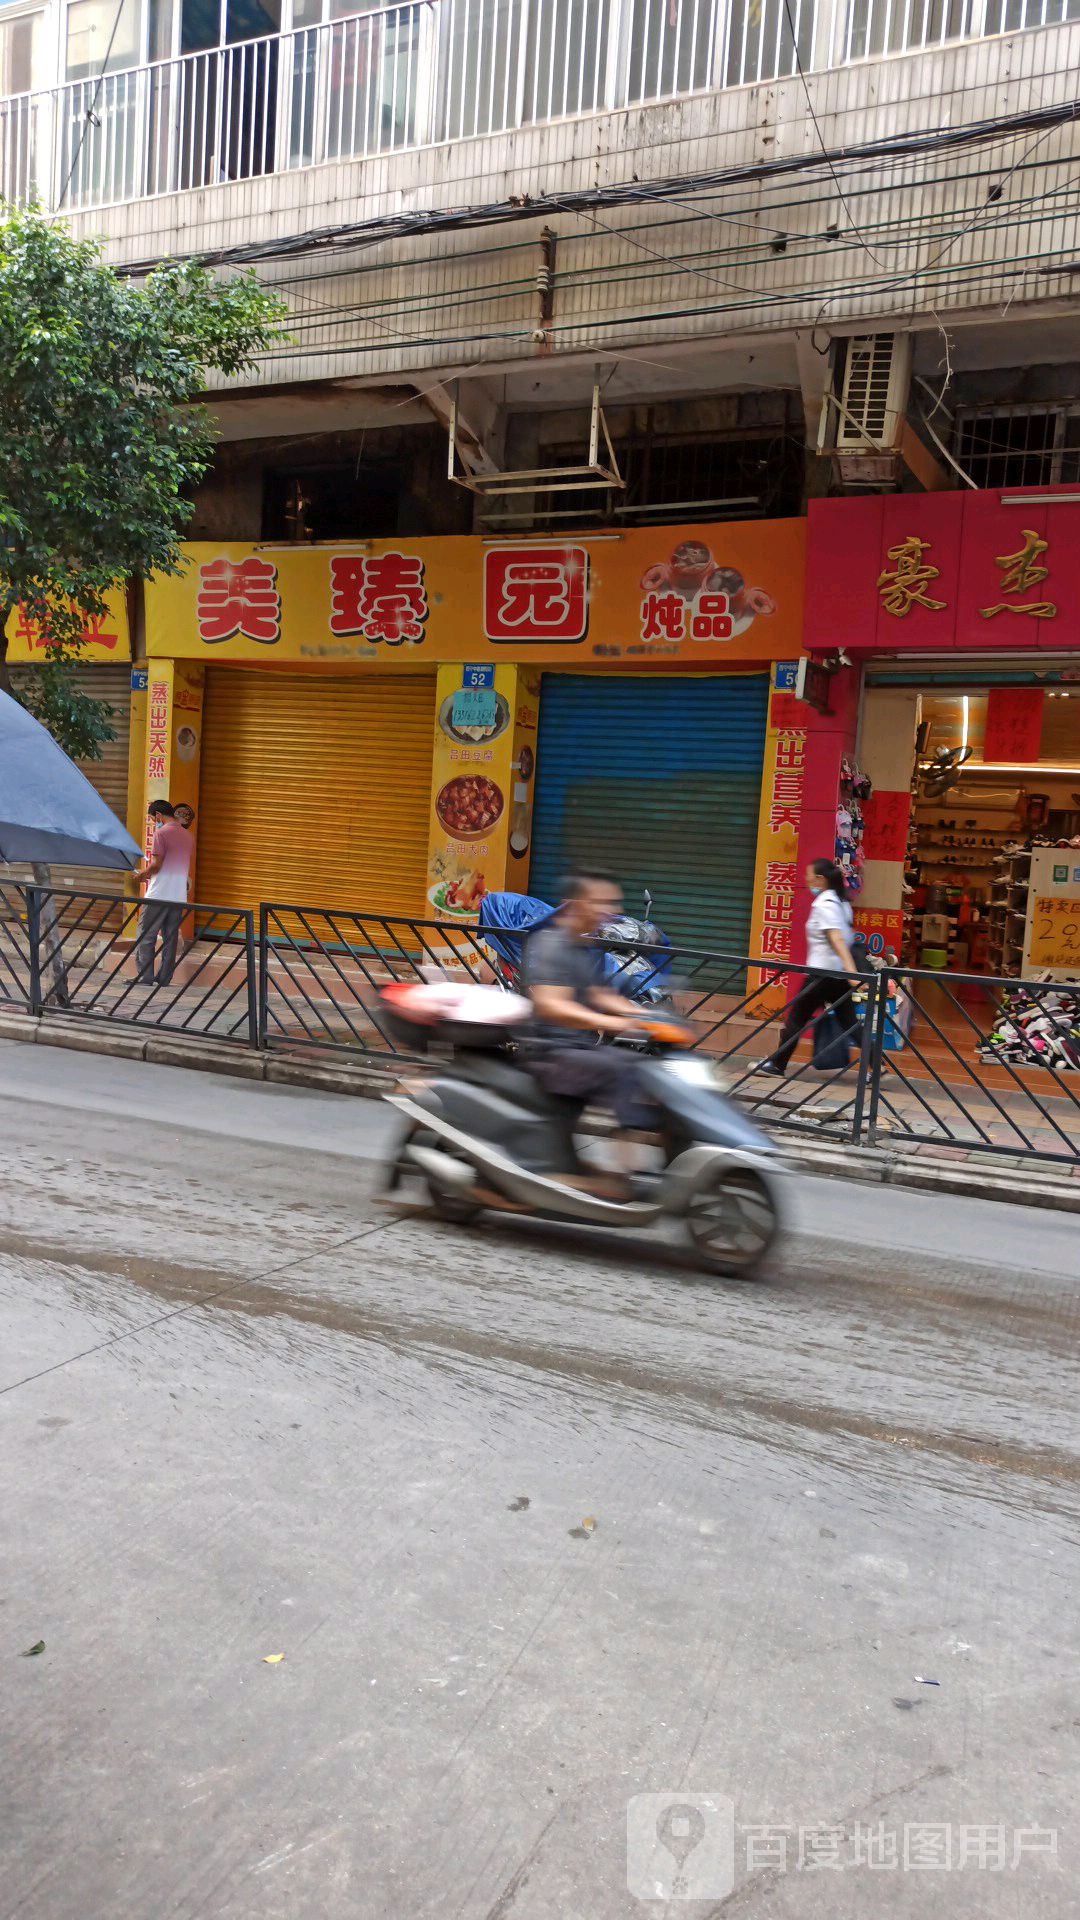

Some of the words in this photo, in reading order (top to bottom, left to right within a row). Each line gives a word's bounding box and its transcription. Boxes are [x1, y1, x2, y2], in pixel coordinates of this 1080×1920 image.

[876, 529, 1057, 618] 豪杰
[639, 590, 735, 641] 炖品
[139, 677, 148, 688] 5
[470, 673, 486, 686] 52
[148, 682, 169, 779] 蒸出天然
[854, 912, 900, 928] 特卖区
[1038, 918, 1078, 940] 20
